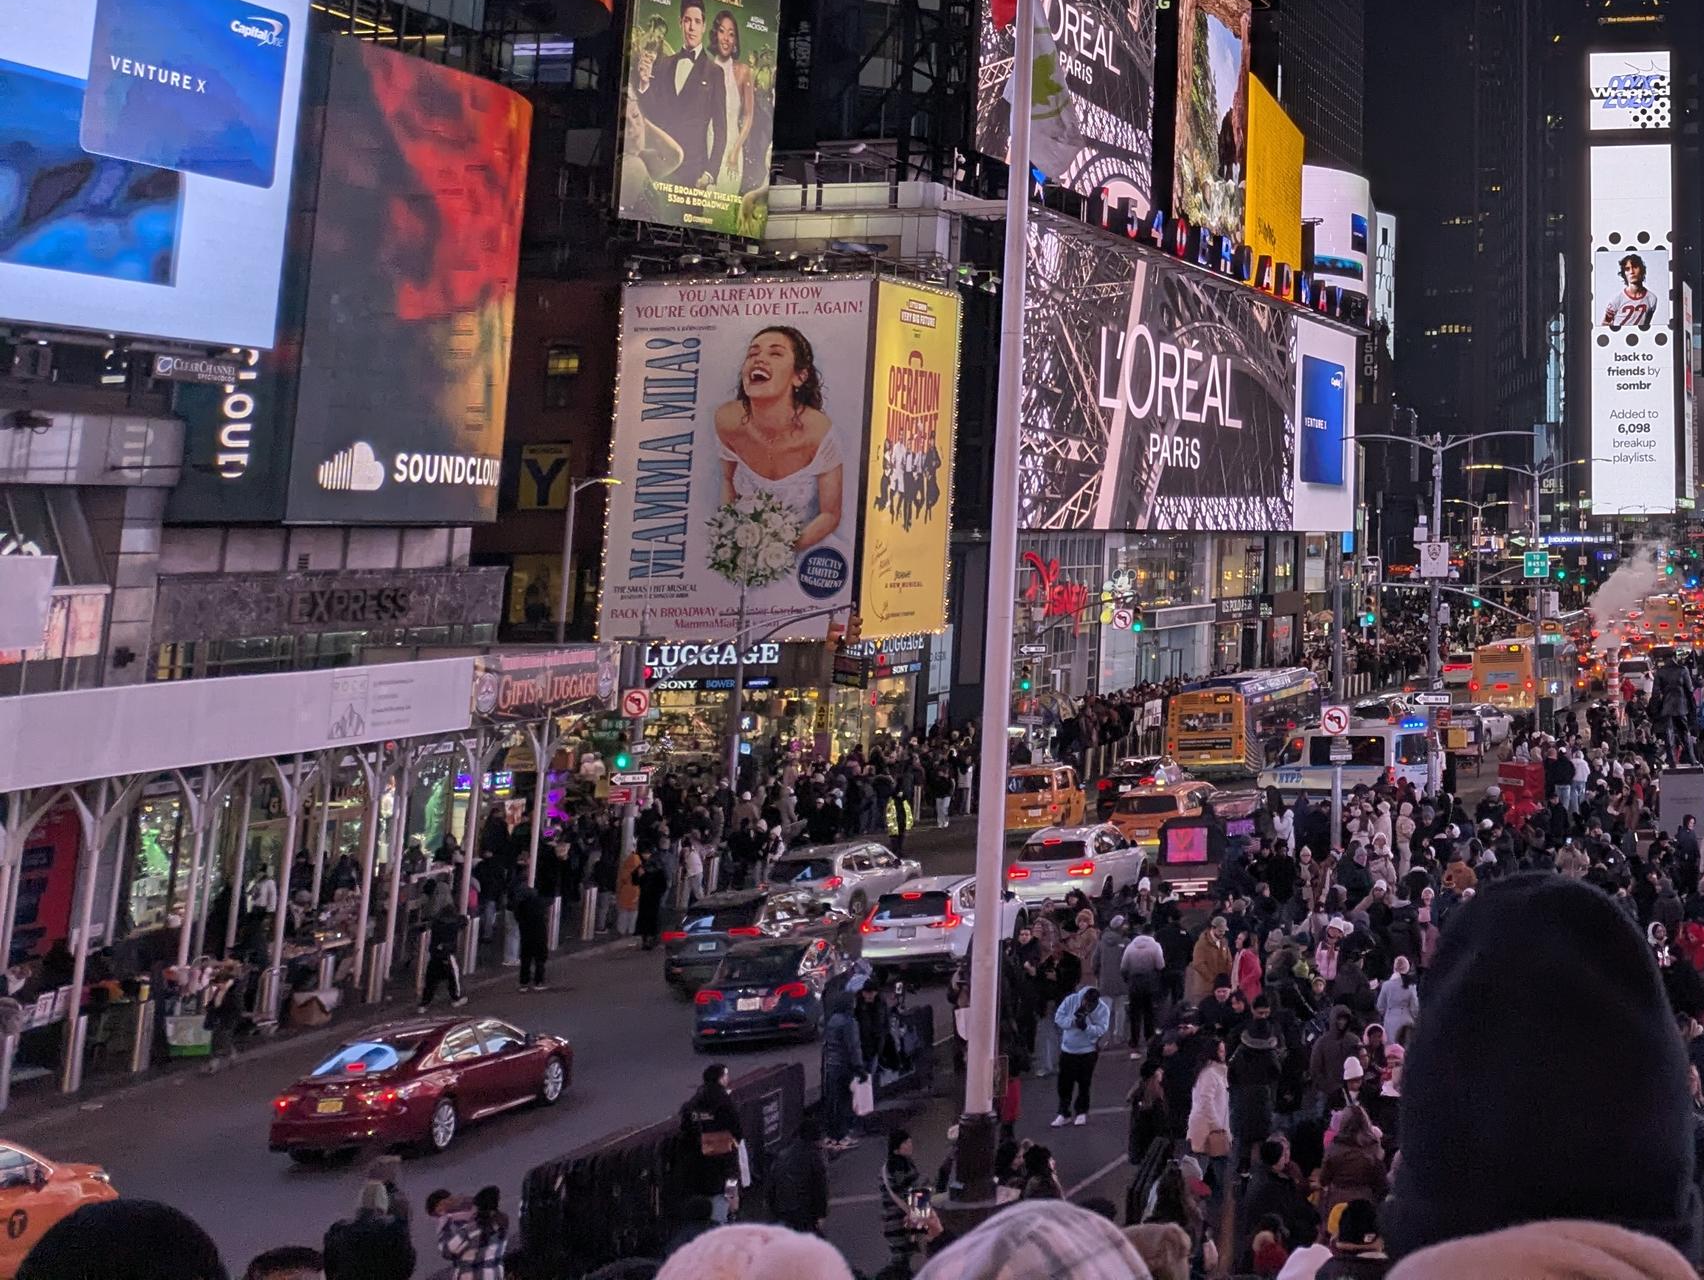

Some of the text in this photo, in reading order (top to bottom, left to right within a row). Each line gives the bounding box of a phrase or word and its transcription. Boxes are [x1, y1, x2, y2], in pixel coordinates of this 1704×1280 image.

[110, 55, 207, 94] VENTURE X
[1591, 87, 1670, 99] Wrapped
[674, 184, 743, 204] BROADWAY THEATRE
[692, 197, 730, 211] BROADWAY
[1100, 186, 1188, 258] 1540
[1196, 227, 1344, 318] BROADWAY
[678, 286, 823, 302] YOU ALREADY KNOW
[635, 300, 864, 319] YOU'RE GONNA LOVE IT... AGAIN!
[1614, 352, 1653, 361] back to
[641, 336, 702, 422] MIA!
[1099, 324, 1242, 429] L'ORÉAL
[1607, 366, 1660, 378] friends by
[888, 365, 940, 414] OPERATION
[1616, 381, 1651, 390] sombr
[1609, 409, 1658, 419] Added to
[1617, 423, 1651, 436] 6,098
[1613, 438, 1656, 449] breakup
[1613, 452, 1656, 464] playlists.
[524, 458, 569, 507] Y
[629, 430, 696, 580] MAMMA
[807, 557, 844, 571] STRICTLY
[807, 566, 840, 580] LIMITED
[667, 584, 697, 592] MUSICAL
[800, 576, 844, 589] ENGAGEMENT
[291, 588, 410, 624] EXPRESS
[610, 606, 717, 619] BACK BROADWAY
[882, 635, 925, 654] LUGGAGE
[645, 643, 780, 666] LUGGAGE
[892, 664, 909, 675] SONY
[499, 673, 600, 710] GIFTS LUGGAGE
[658, 679, 698, 690] SONY
[706, 679, 736, 689] BOWER
[818, 706, 826, 729] ATM
[1277, 773, 1303, 784] NYPD
